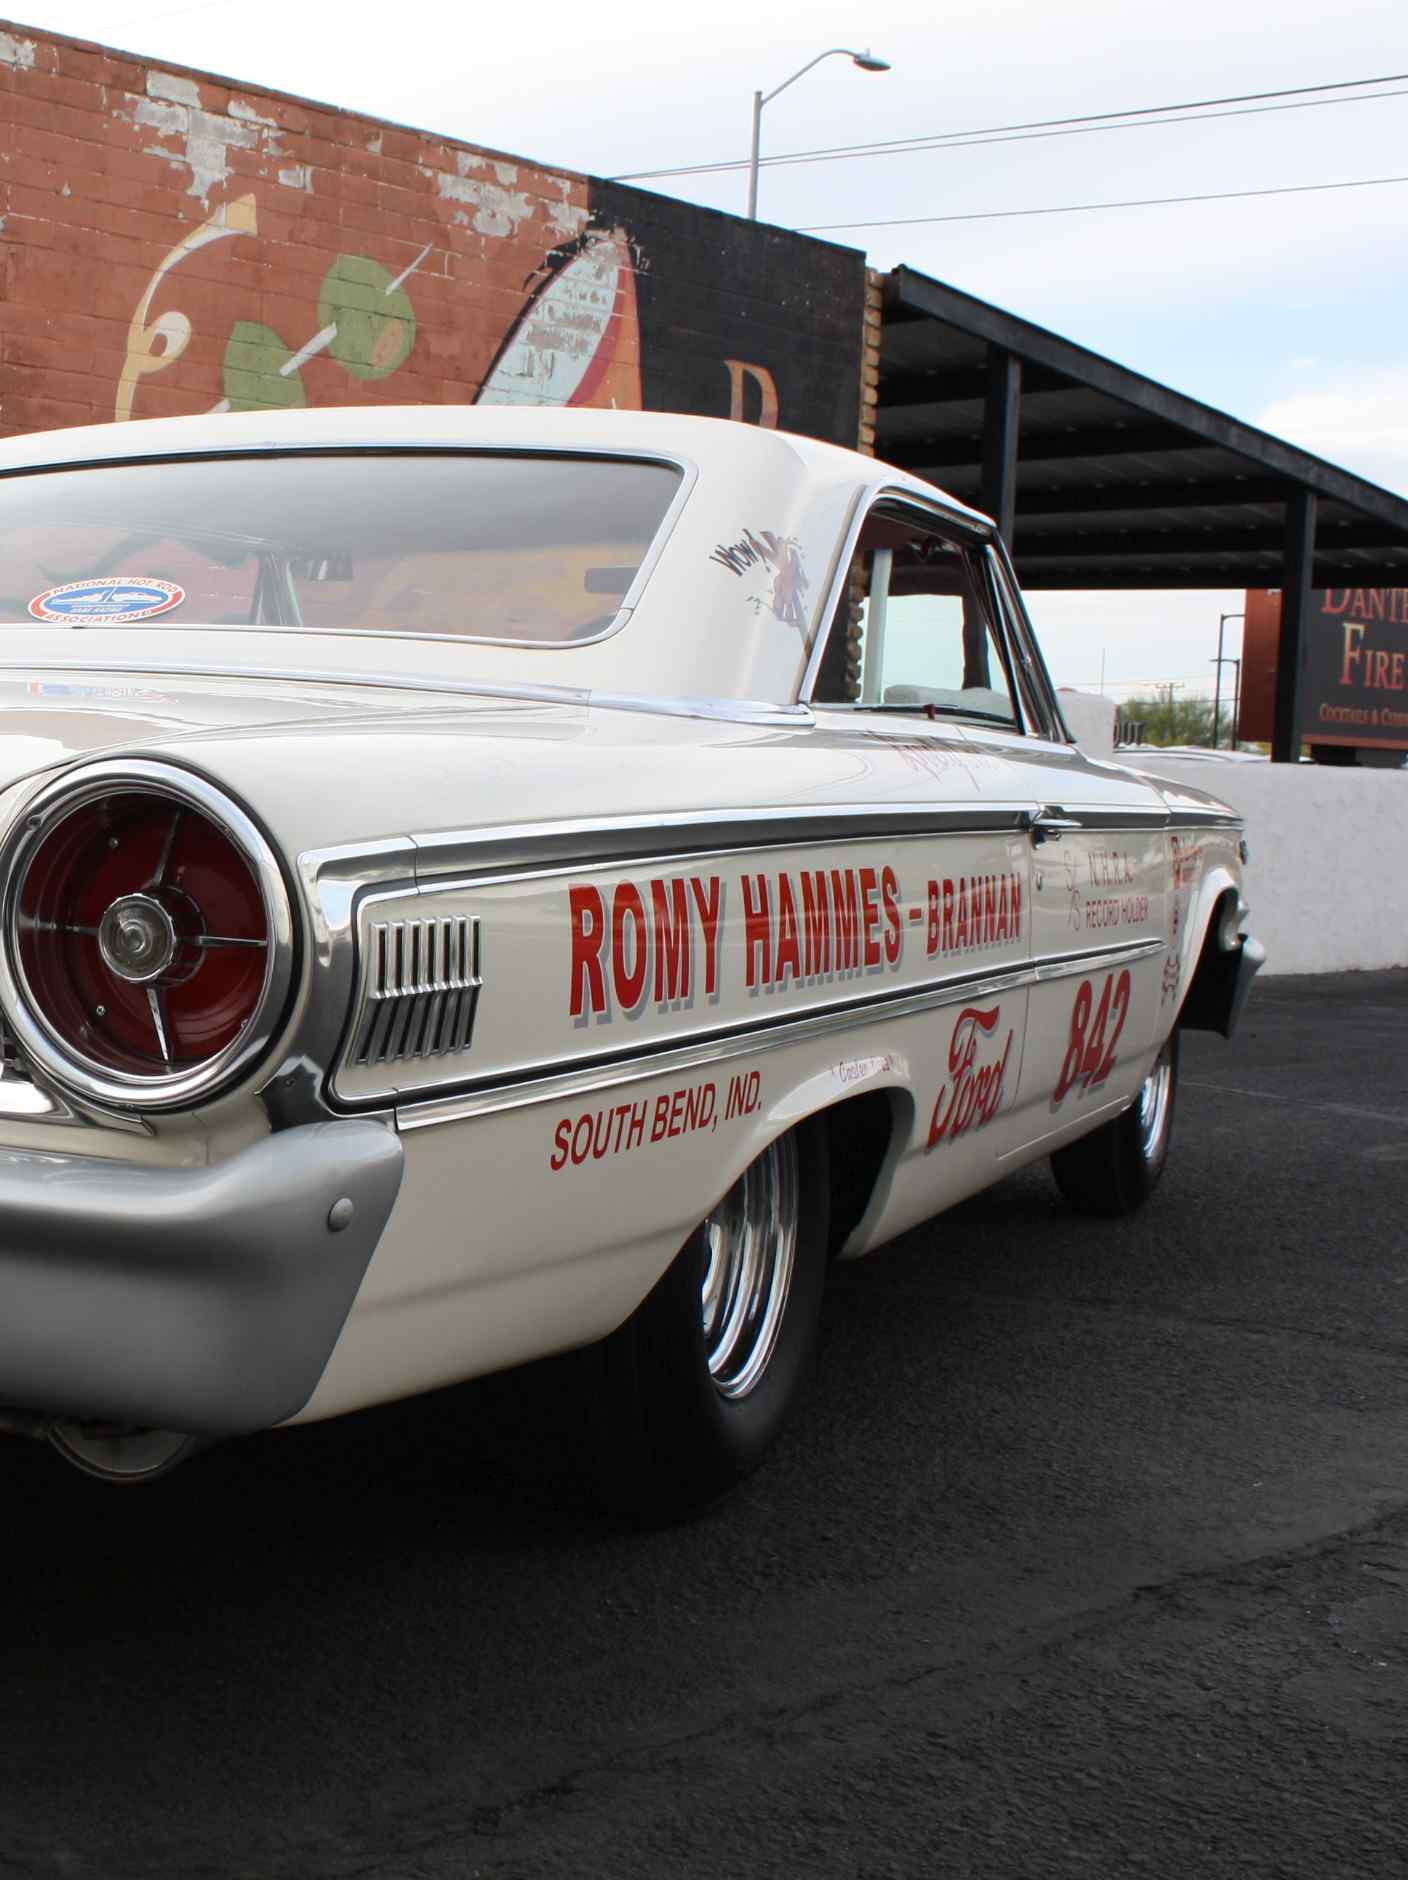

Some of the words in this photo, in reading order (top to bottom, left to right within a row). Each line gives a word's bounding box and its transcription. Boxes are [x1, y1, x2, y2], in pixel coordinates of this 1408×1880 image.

[53, 578, 123, 594] NATIONAL
[128, 578, 150, 586] HOT
[152, 580, 179, 593] ROD
[1340, 623, 1404, 690] FIRE
[569, 876, 724, 1017] ROMY
[741, 866, 902, 988] HAMMES
[927, 873, 1021, 954] BRANNAN
[927, 1004, 1014, 1150] Ford
[1053, 969, 1131, 1104] 842
[550, 1100, 648, 1171] SOUTH
[650, 1082, 718, 1143] BEND,
[724, 1070, 762, 1121] IND.
